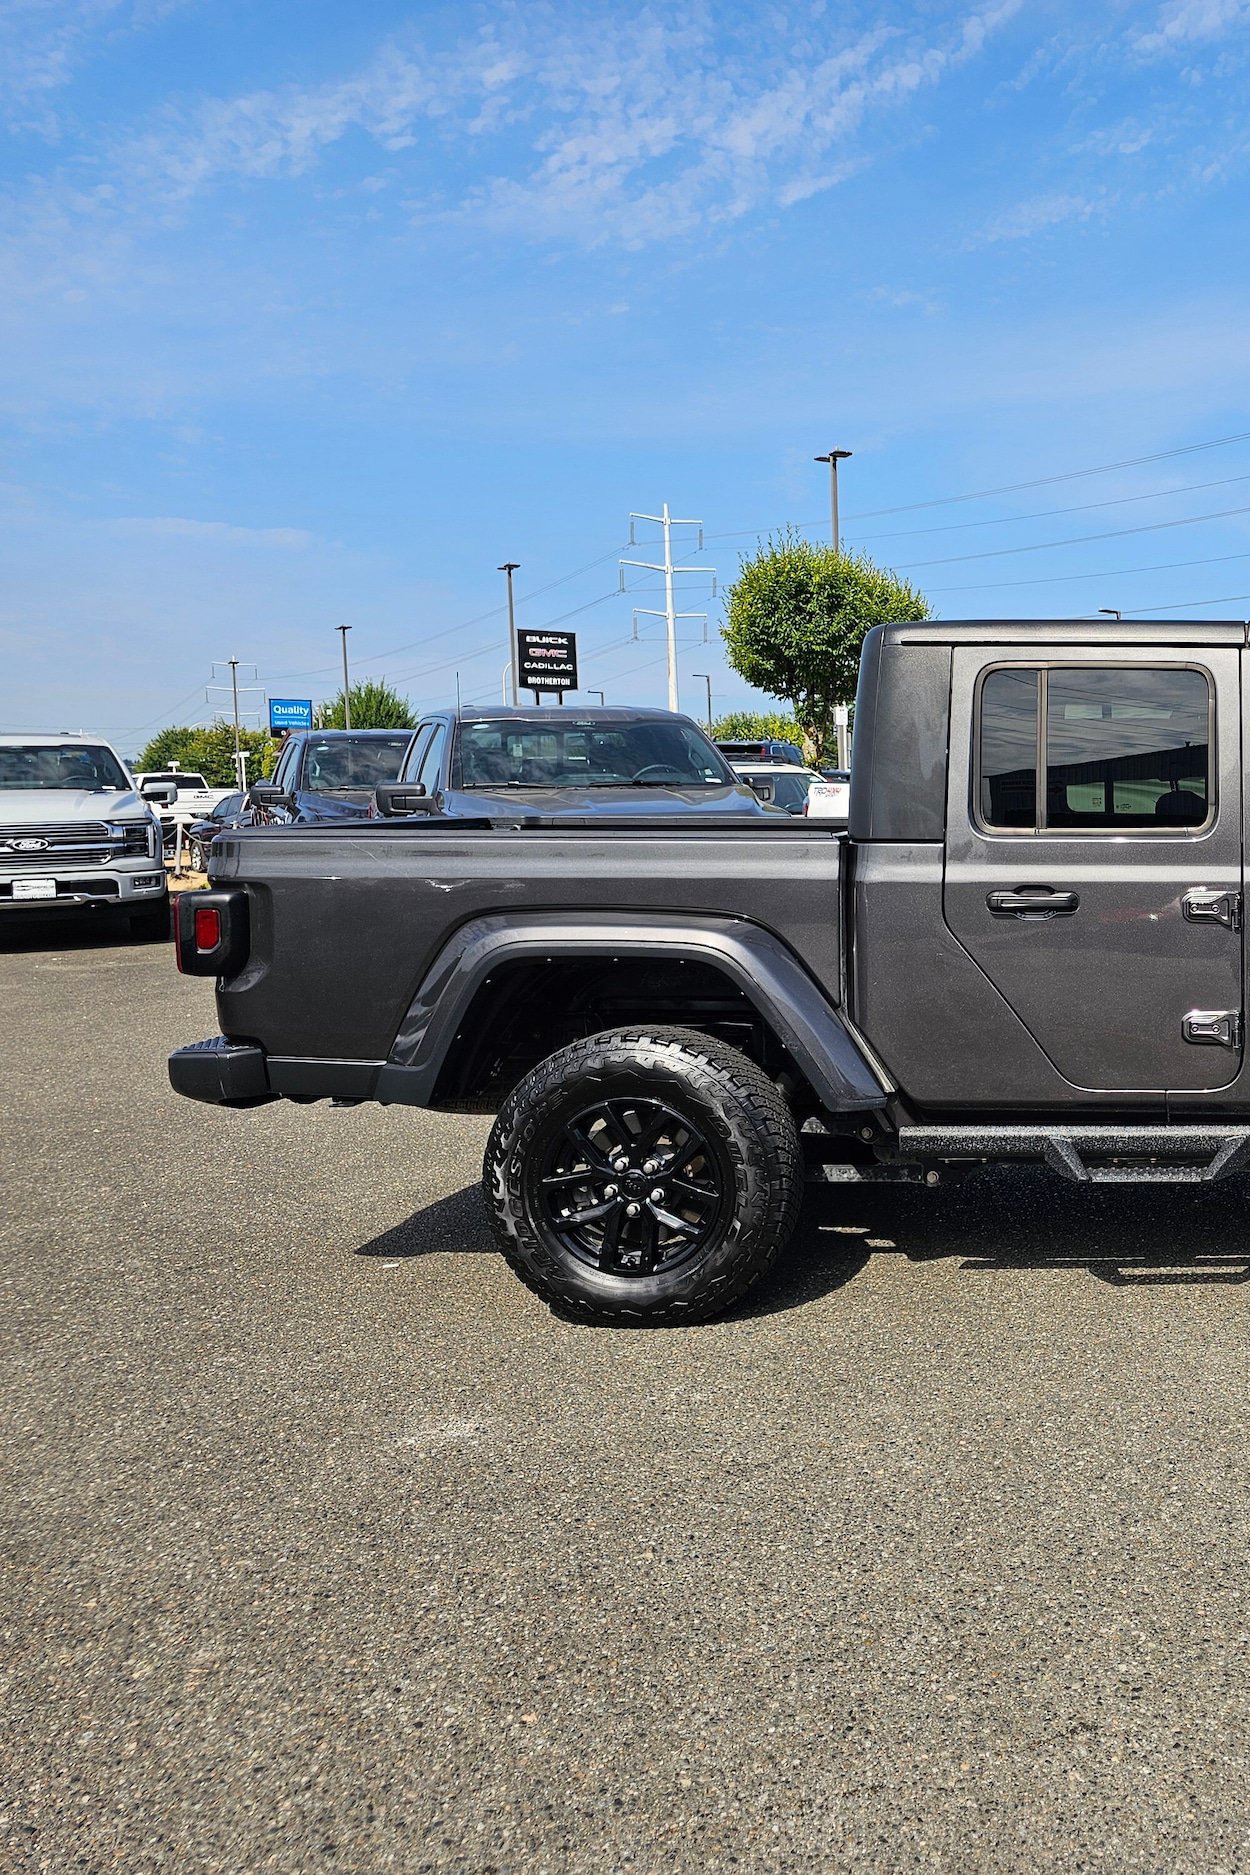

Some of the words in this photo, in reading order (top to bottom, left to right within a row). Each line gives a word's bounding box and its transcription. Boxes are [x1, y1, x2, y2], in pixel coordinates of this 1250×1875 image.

[525, 635, 569, 645] BUICK
[528, 647, 568, 659] GMC
[524, 661, 574, 671] CADILLAC
[527, 676, 571, 686] BROTHERTON
[273, 705, 310, 717] Quality
